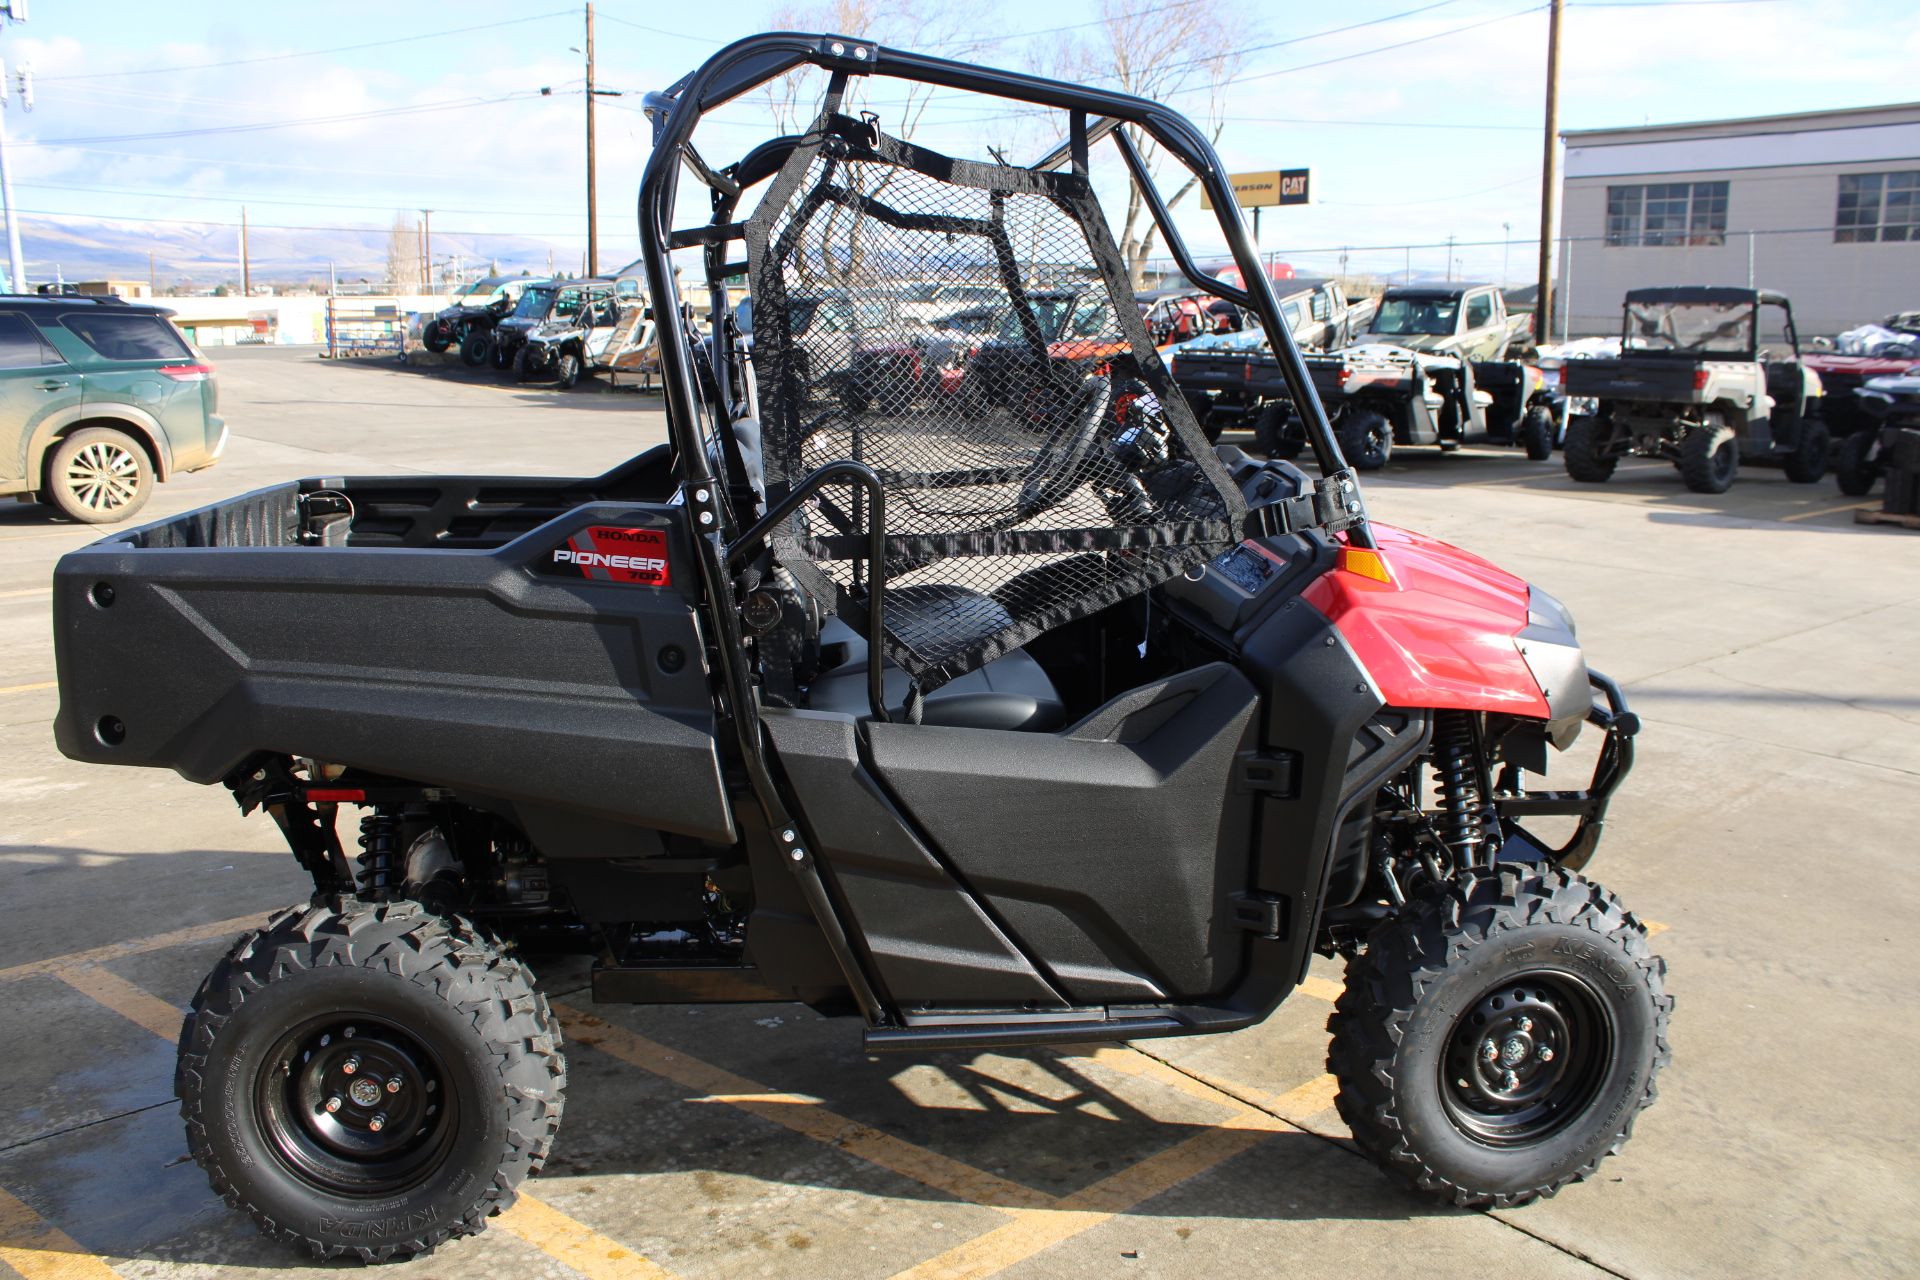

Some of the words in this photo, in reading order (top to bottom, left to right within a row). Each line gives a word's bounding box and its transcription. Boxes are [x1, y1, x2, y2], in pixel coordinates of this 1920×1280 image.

[1281, 176, 1306, 196] CAT
[597, 530, 660, 543] HONDA
[553, 549, 665, 571] PIONEER
[627, 571, 663, 580] 700
[1553, 936, 1637, 1000] KENDA
[319, 1203, 439, 1240] KENDA
